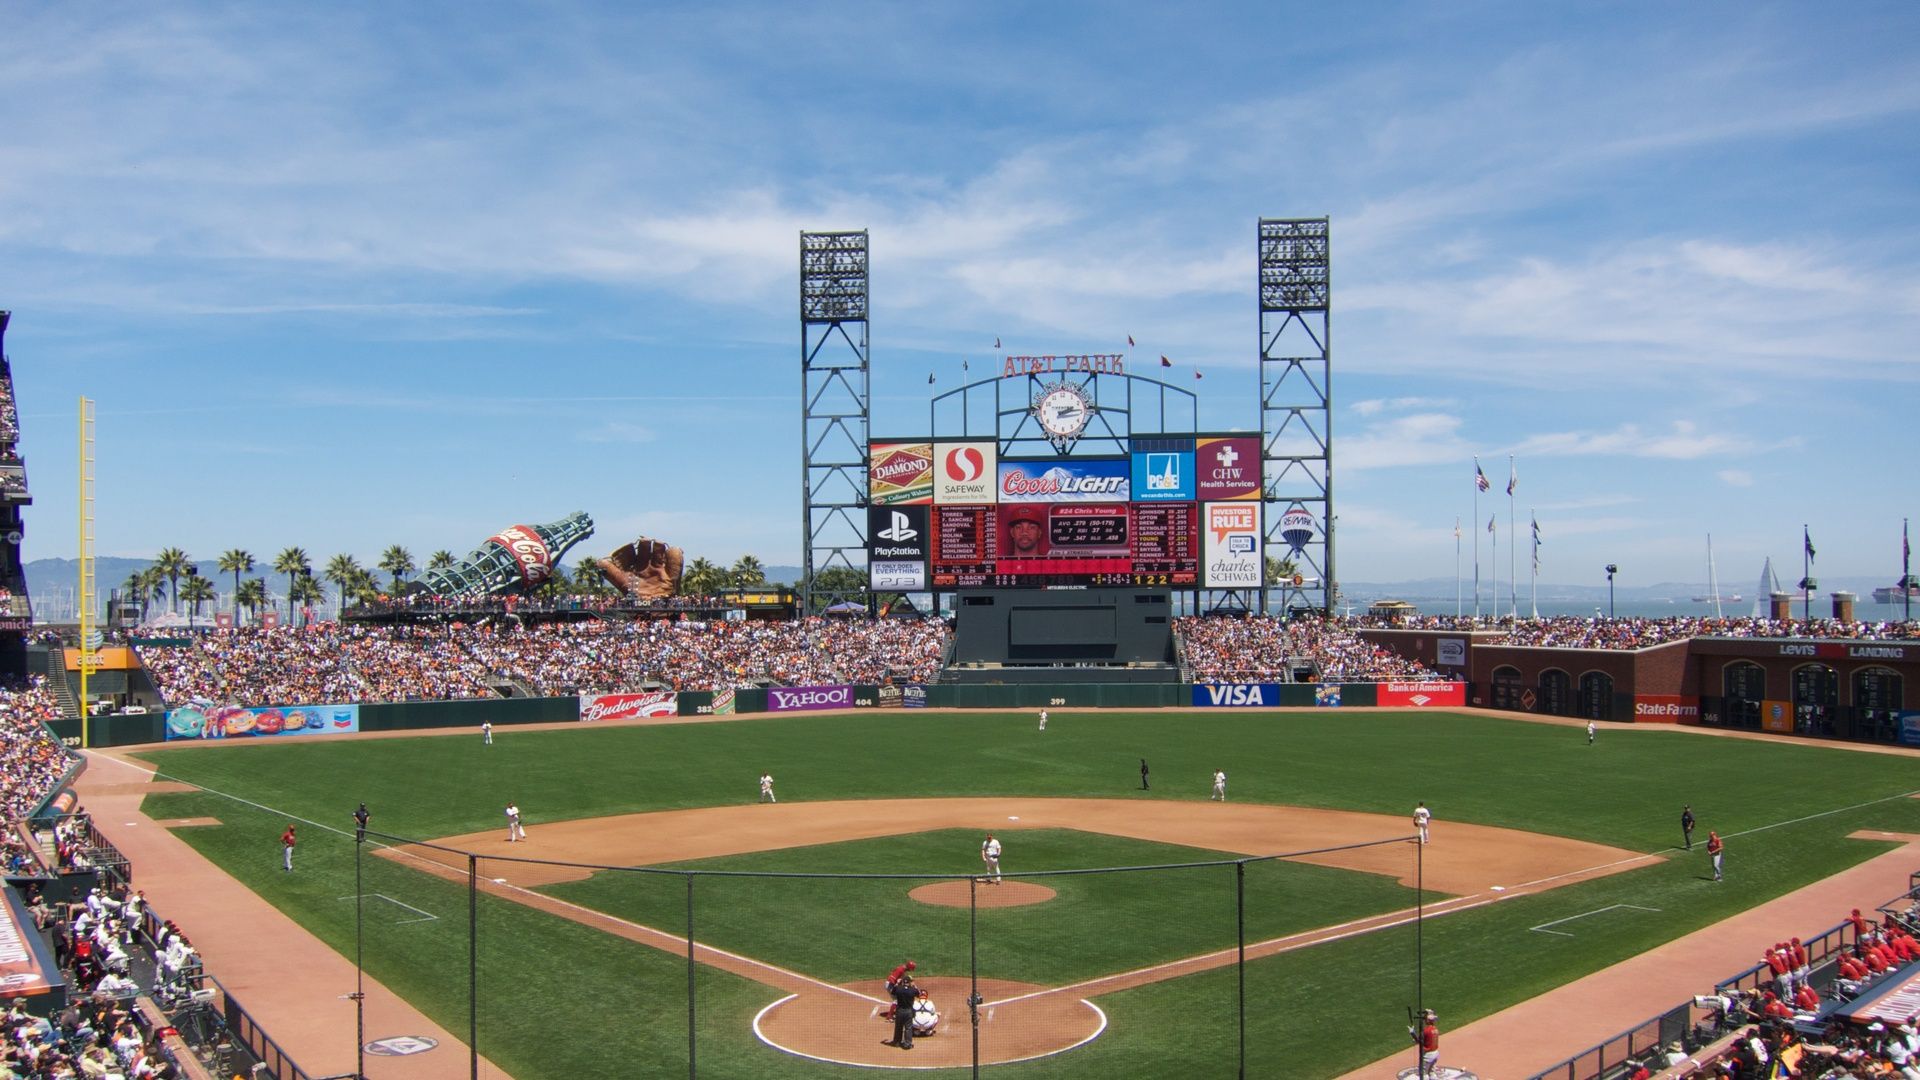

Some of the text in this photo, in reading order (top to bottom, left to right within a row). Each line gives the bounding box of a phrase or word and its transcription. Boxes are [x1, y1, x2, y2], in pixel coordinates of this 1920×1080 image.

[1004, 354, 1123, 378] AT&T PARK
[876, 459, 928, 480] DIAMOND
[1212, 469, 1243, 480] CHW
[1003, 470, 1124, 494] Coors LIGHT
[1150, 474, 1178, 488] PG&E
[945, 485, 985, 494] SAFEWAY
[888, 492, 910, 502] Culinary
[1213, 516, 1252, 528] RULE
[875, 547, 920, 557] PlayStation
[1211, 559, 1256, 572] charles
[881, 578, 915, 586] PS3
[1135, 576, 1140, 584] 1
[1147, 576, 1154, 584] 2
[1160, 576, 1167, 584] 2
[1211, 572, 1256, 581] SCHWAB
[1850, 647, 1903, 658] LANDING
[1410, 684, 1419, 692] of
[712, 690, 735, 710] EMERALD
[772, 688, 849, 709] YAHOO!
[1205, 686, 1263, 705] VISA
[586, 693, 665, 721] Budweiser
[1635, 703, 1697, 716] State Farm
[1704, 713, 1718, 721] 365
[62, 736, 80, 745] 339
